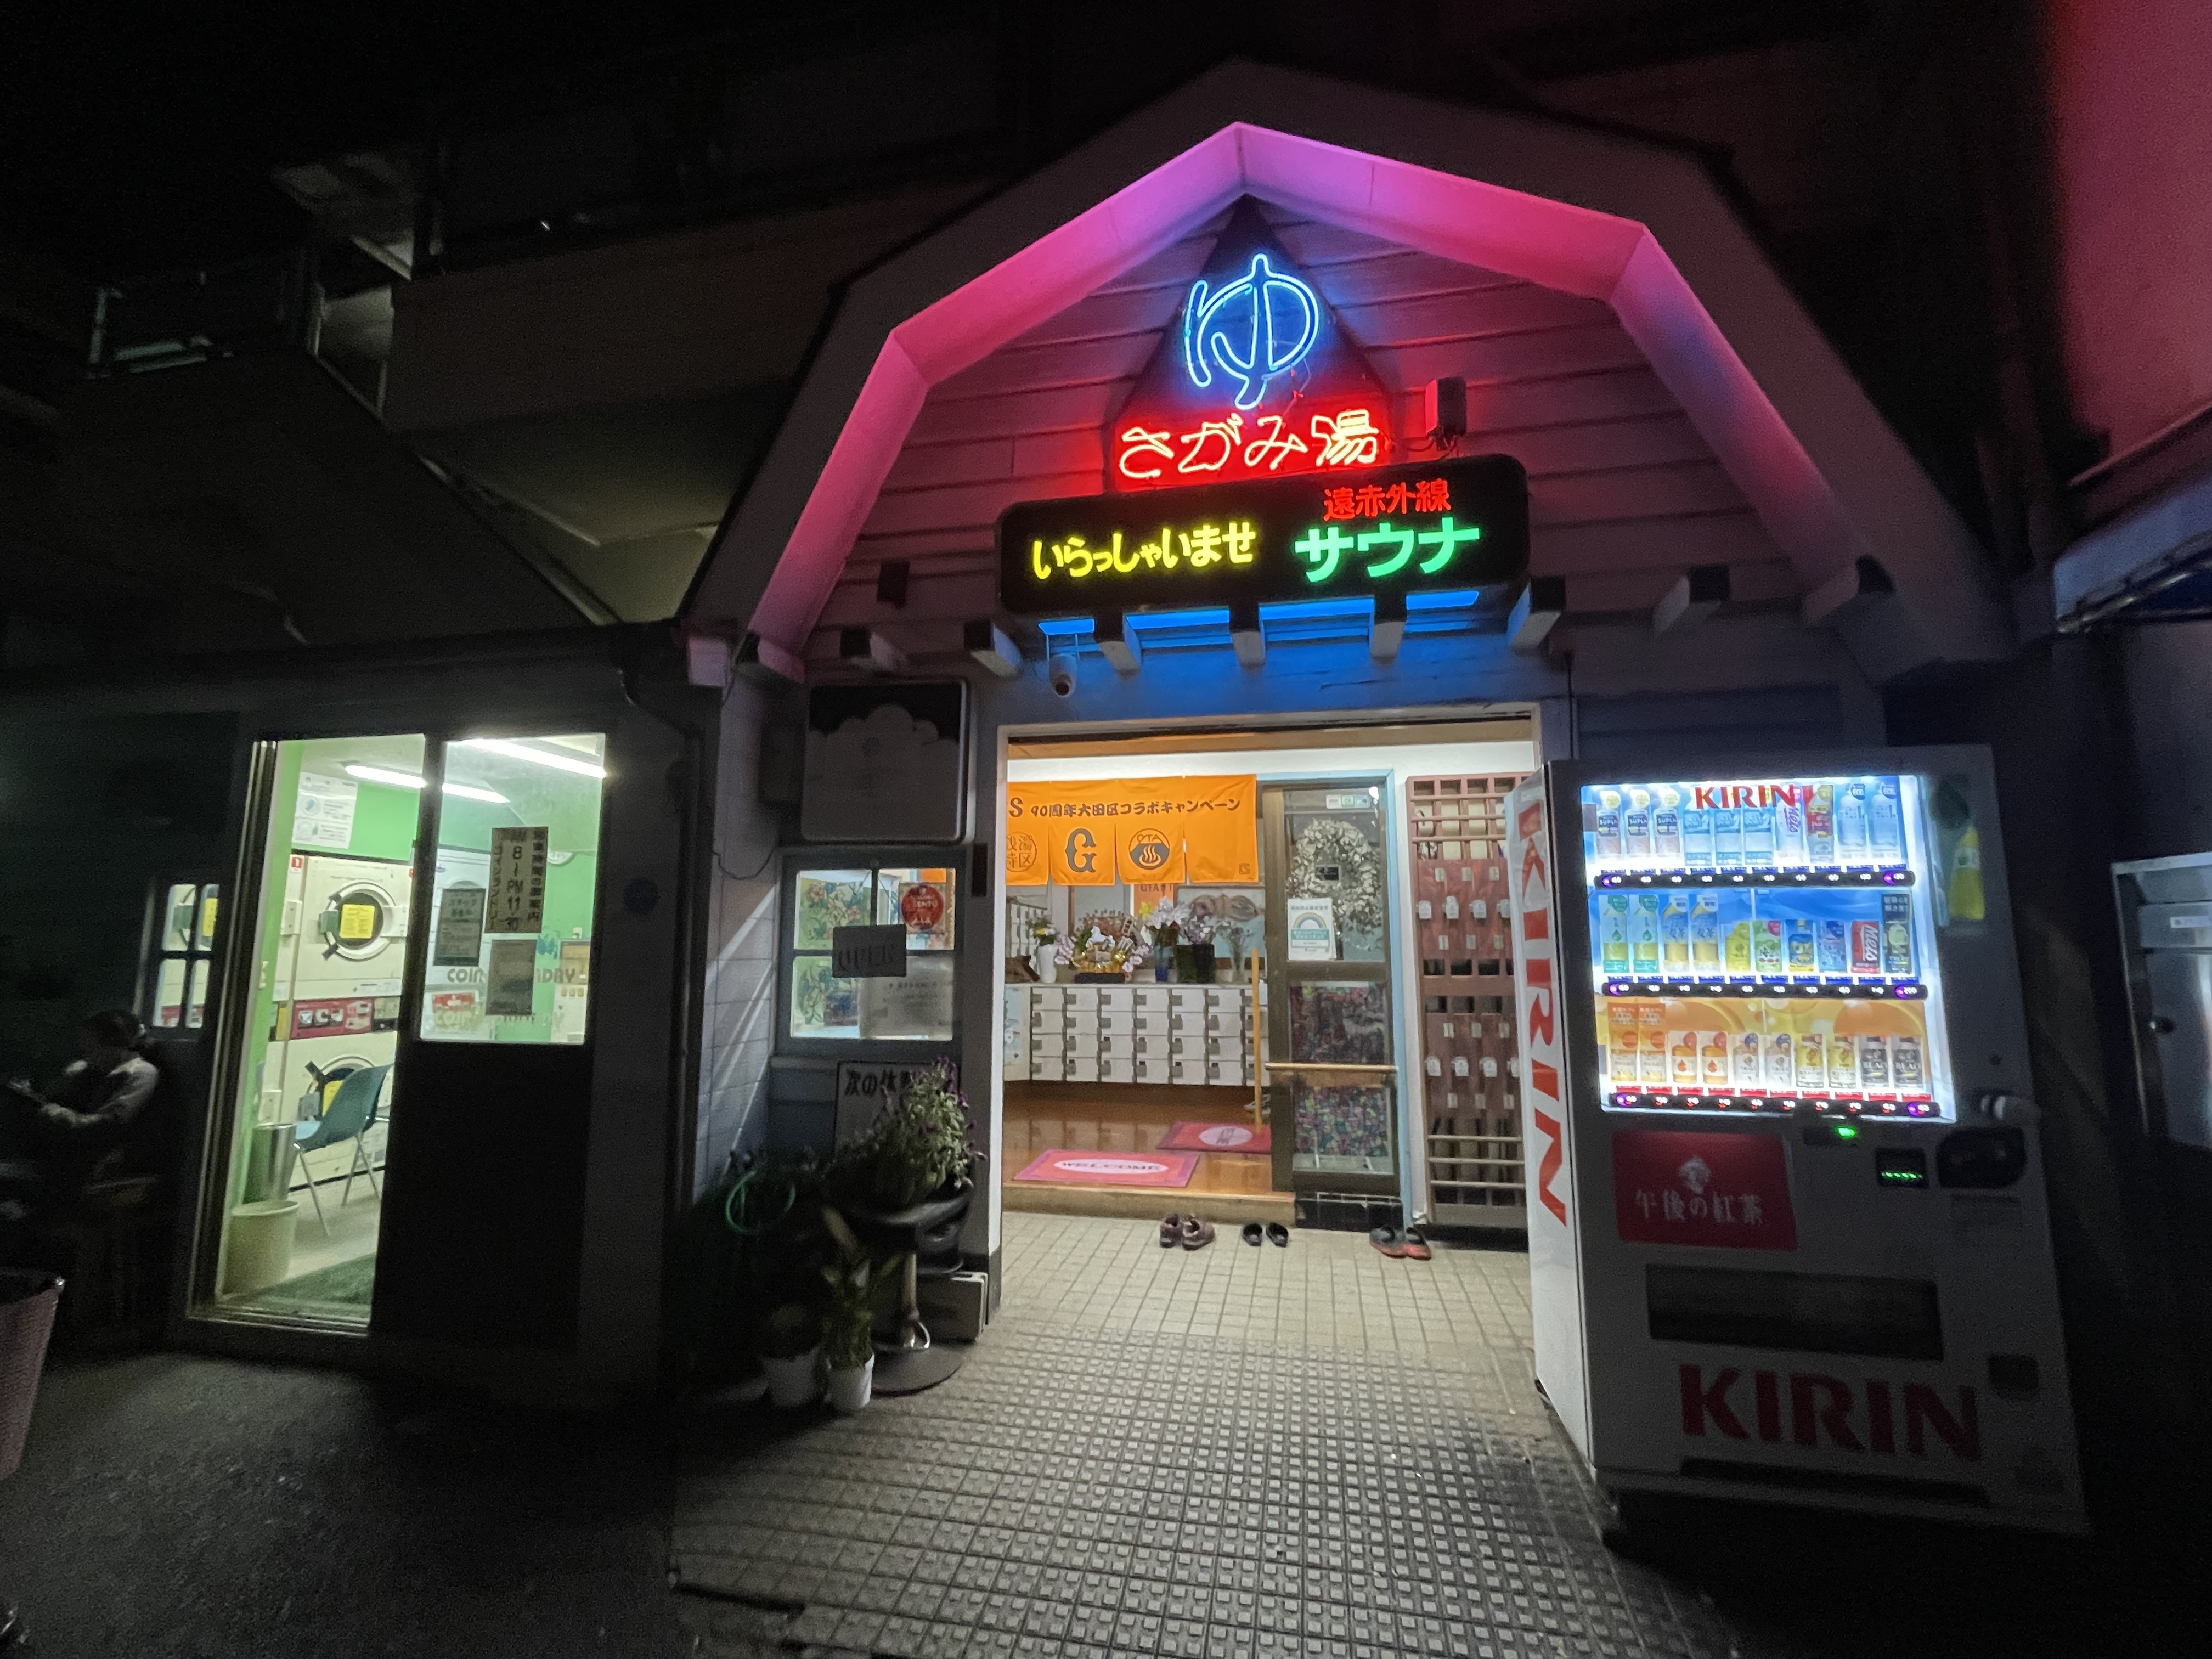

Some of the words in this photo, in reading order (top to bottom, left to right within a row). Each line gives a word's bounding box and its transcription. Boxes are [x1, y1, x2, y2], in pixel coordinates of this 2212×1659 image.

[1183, 252, 1319, 410] ゆ
[1119, 409, 1379, 479] さがみ湯
[1323, 478, 1452, 522] 遠赤外線
[1032, 521, 1257, 580] いらっしゃいませ
[1294, 516, 1481, 583] サウナ
[1694, 784, 1796, 809] KIRIN
[1065, 828, 1097, 873] G
[1136, 834, 1161, 843] OTA
[1517, 799, 1567, 1228] KIRIN
[1634, 1189, 1763, 1228] 午後の紅茶
[1679, 1363, 1982, 1463] KIRIN
